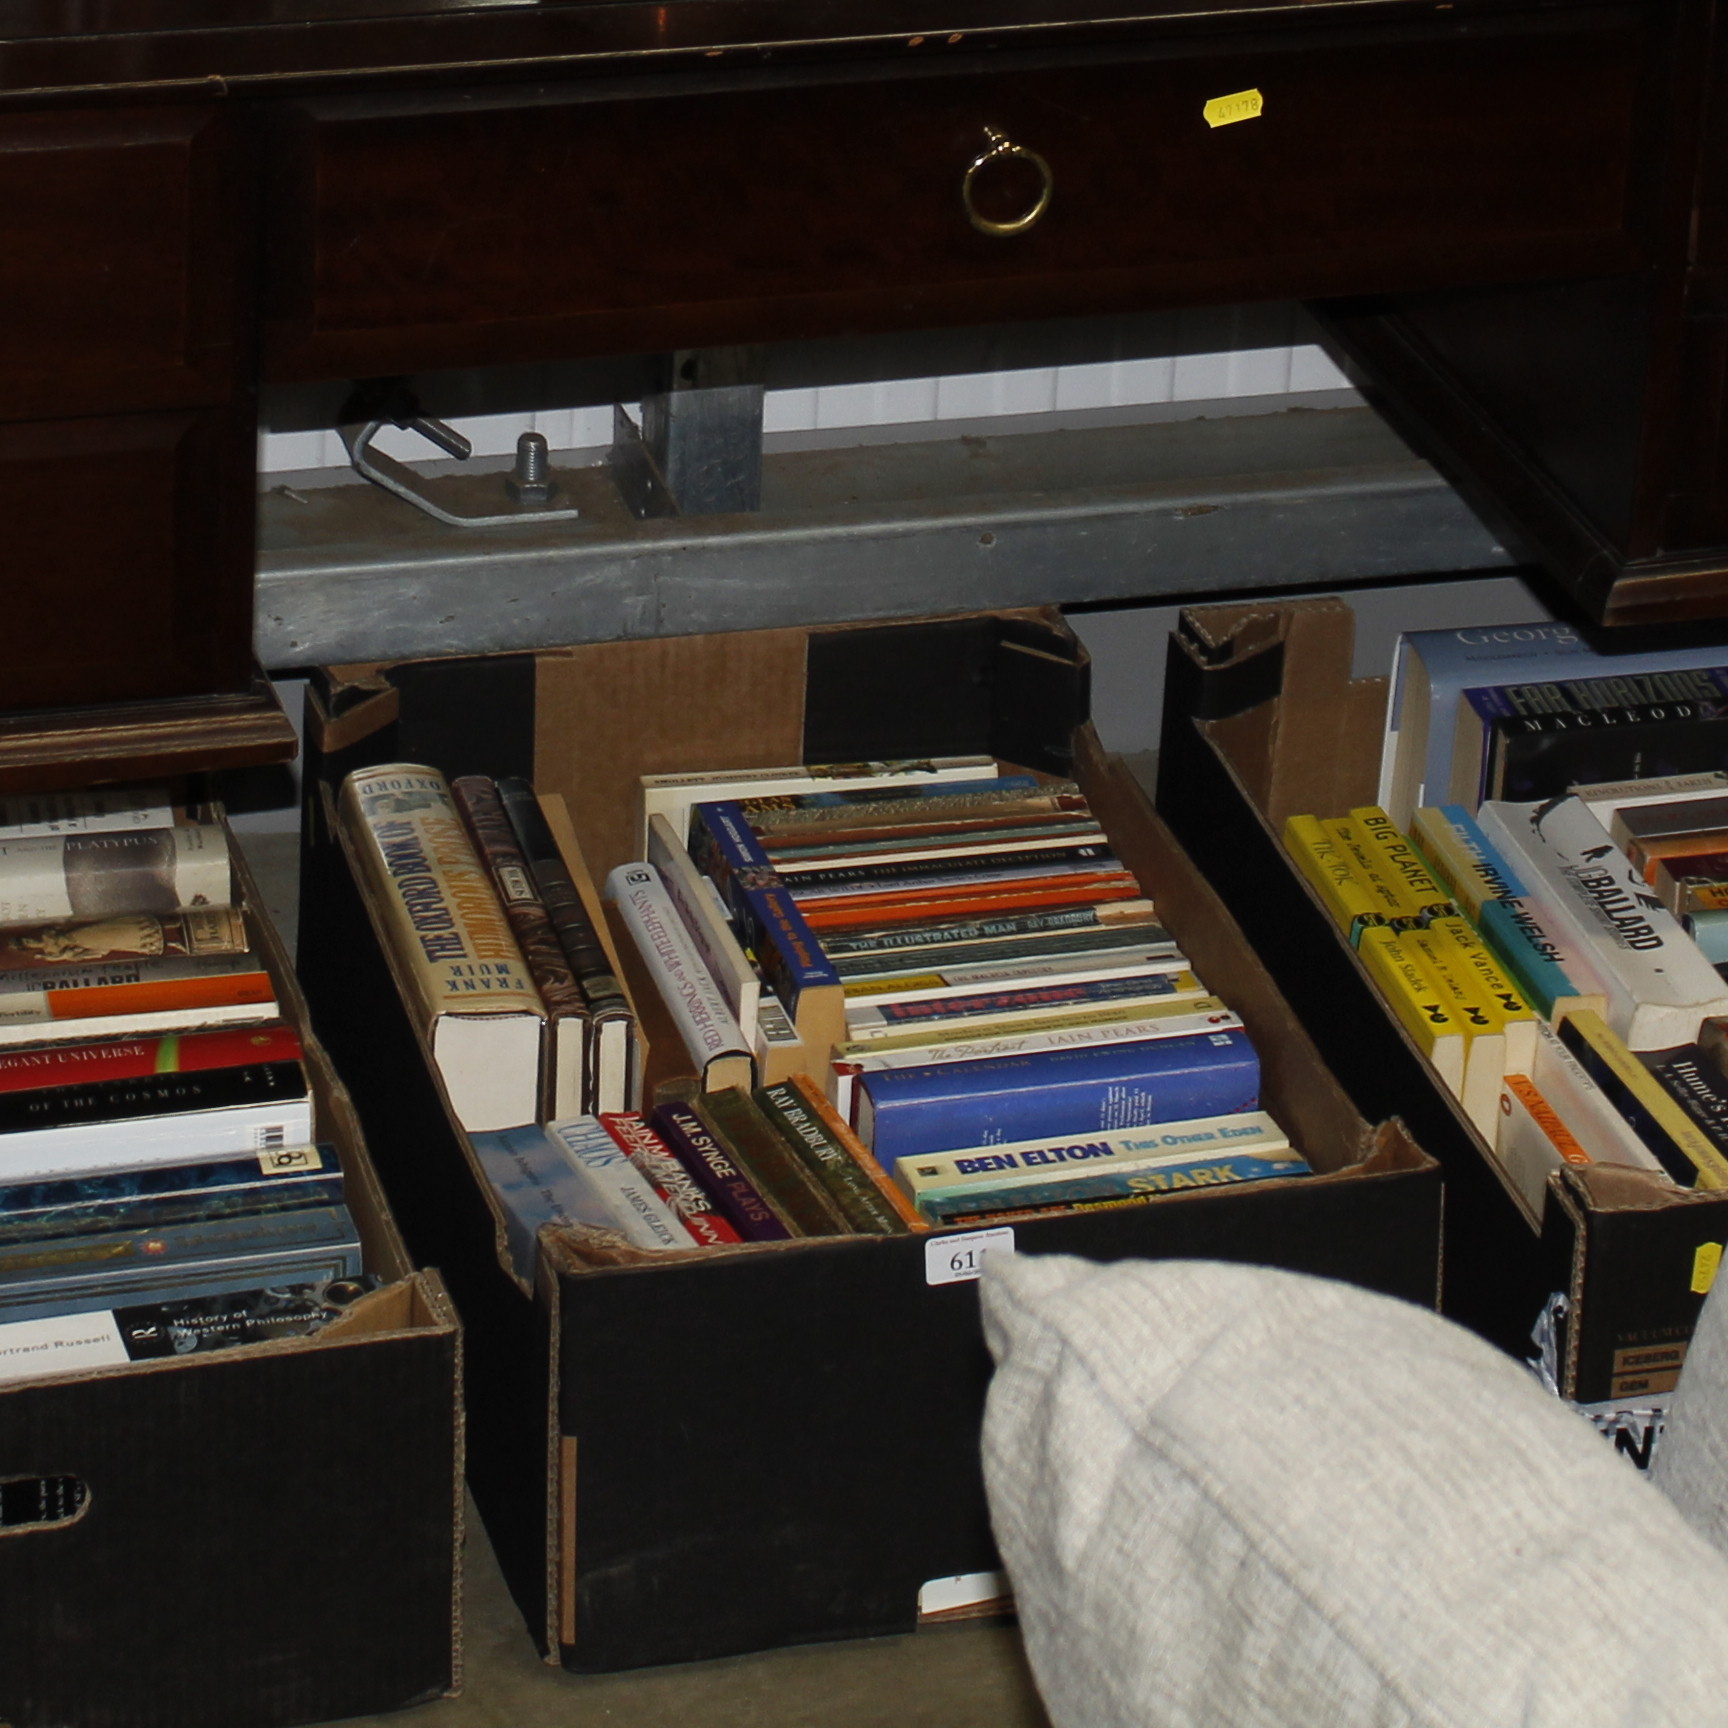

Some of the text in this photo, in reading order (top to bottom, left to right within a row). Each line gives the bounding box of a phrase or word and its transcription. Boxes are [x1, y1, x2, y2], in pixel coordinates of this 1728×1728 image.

[1504, 682, 1572, 715] FAR
[1569, 672, 1722, 712] HORIZONS
[1524, 705, 1692, 732] MACLEOD
[362, 779, 442, 795] OXFORD
[66, 836, 160, 851] PLATYPUS
[1363, 817, 1441, 895] BIG PLANET
[819, 870, 865, 881] PEARS
[992, 852, 1067, 864] DECEPTION
[374, 820, 468, 964] OF BOOK OXFORD THE
[1454, 823, 1564, 964] FILTH IRVINE WELSH
[1580, 874, 1664, 951] BALLARD
[850, 940, 878, 951] THE
[883, 926, 980, 947] ILLUSTRATED
[984, 922, 1017, 934] MAN
[450, 964, 510, 976] MUIR
[1380, 939, 1428, 994] John Sladek
[1446, 922, 1505, 991] Jack Vance
[446, 978, 524, 992] FRANK
[57, 1045, 146, 1063] UNIVERSE
[700, 1027, 725, 1052] RED
[927, 1047, 952, 1060] The
[1047, 1032, 1097, 1046] IAIN
[1101, 1024, 1161, 1040] PEARS
[29, 1100, 53, 1113] OF
[63, 1094, 97, 1109] THE
[108, 1084, 204, 1104] COSMOS
[1672, 1061, 1728, 1113] Hume's
[767, 1085, 842, 1163] RAY BRADBURY
[672, 1113, 772, 1223] J.M. SYNGE PLAYS
[954, 1141, 1117, 1176] BEN ELTON
[1126, 1162, 1244, 1195] STARK
[950, 1248, 987, 1271] 61
[173, 1310, 248, 1328] History of
[173, 1310, 330, 1338] Western Philosophy
[54, 1334, 112, 1349] Russell
